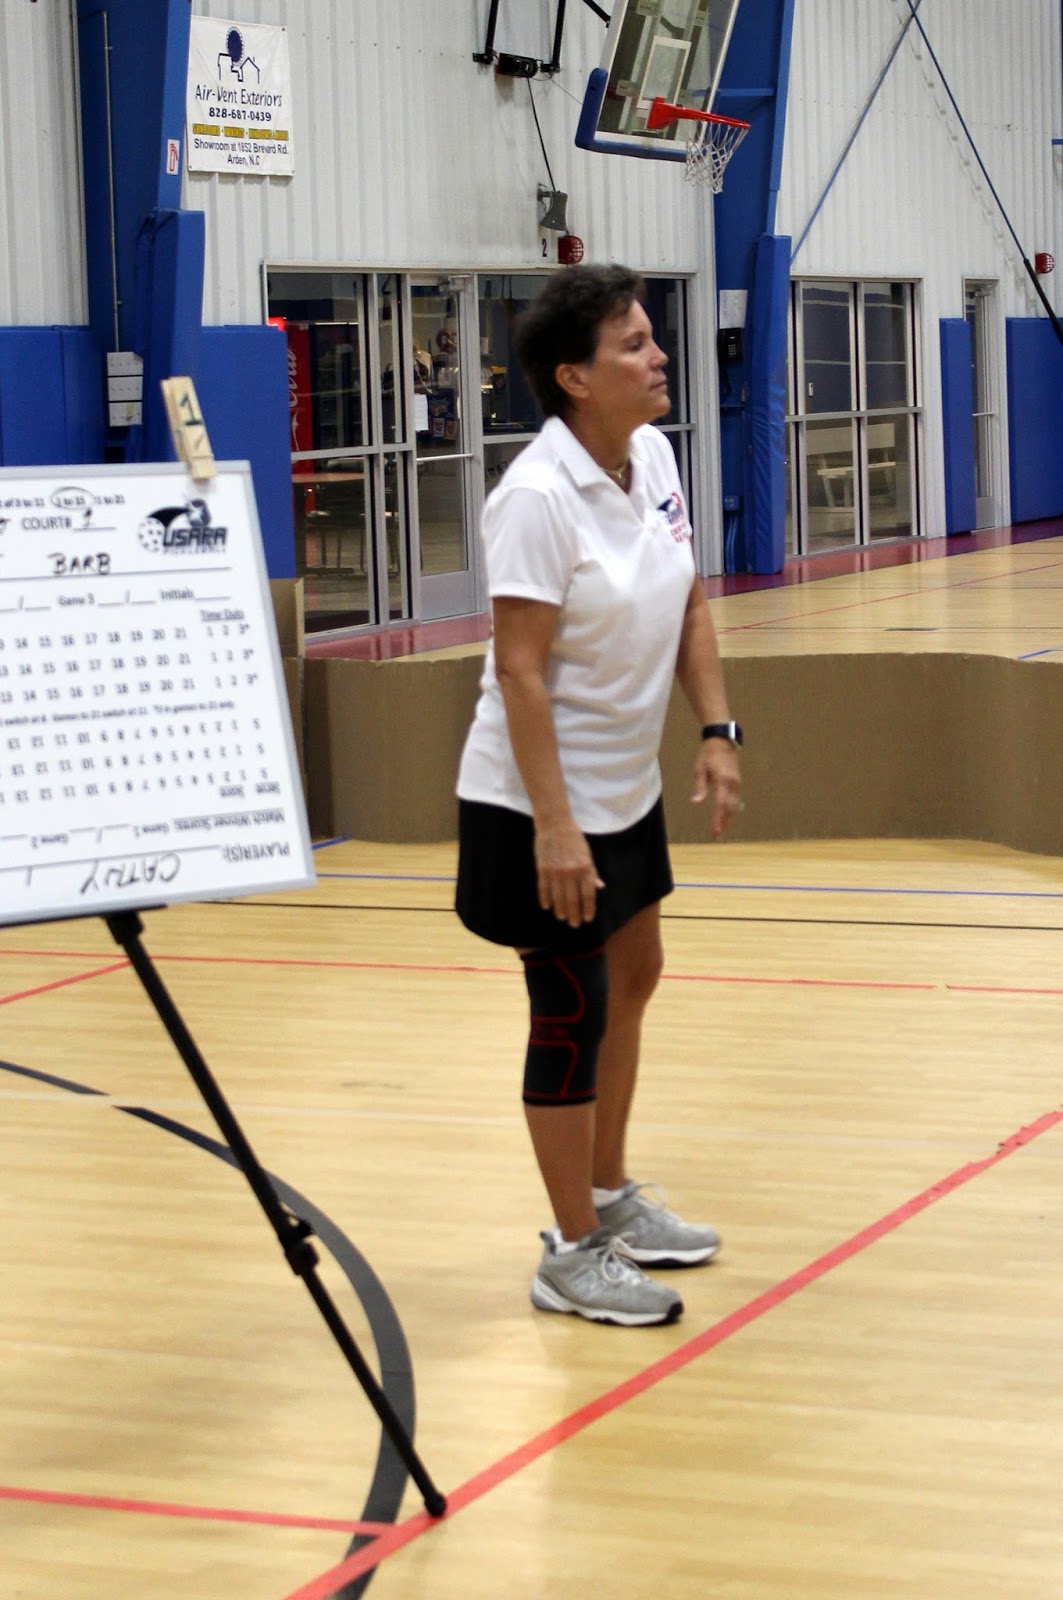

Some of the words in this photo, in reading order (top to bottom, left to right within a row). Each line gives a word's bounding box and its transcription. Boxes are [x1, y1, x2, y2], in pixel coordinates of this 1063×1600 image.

[195, 84, 238, 104] Air-Vent
[241, 88, 282, 107] Exteriors
[209, 107, 272, 121] 828-687-0439
[194, 138, 229, 150] Showroom
[230, 143, 237, 152] at
[238, 142, 252, 153] 1852
[277, 144, 289, 155] Rd.
[227, 154, 248, 165] Arden,
[541, 238, 548, 257] 2
